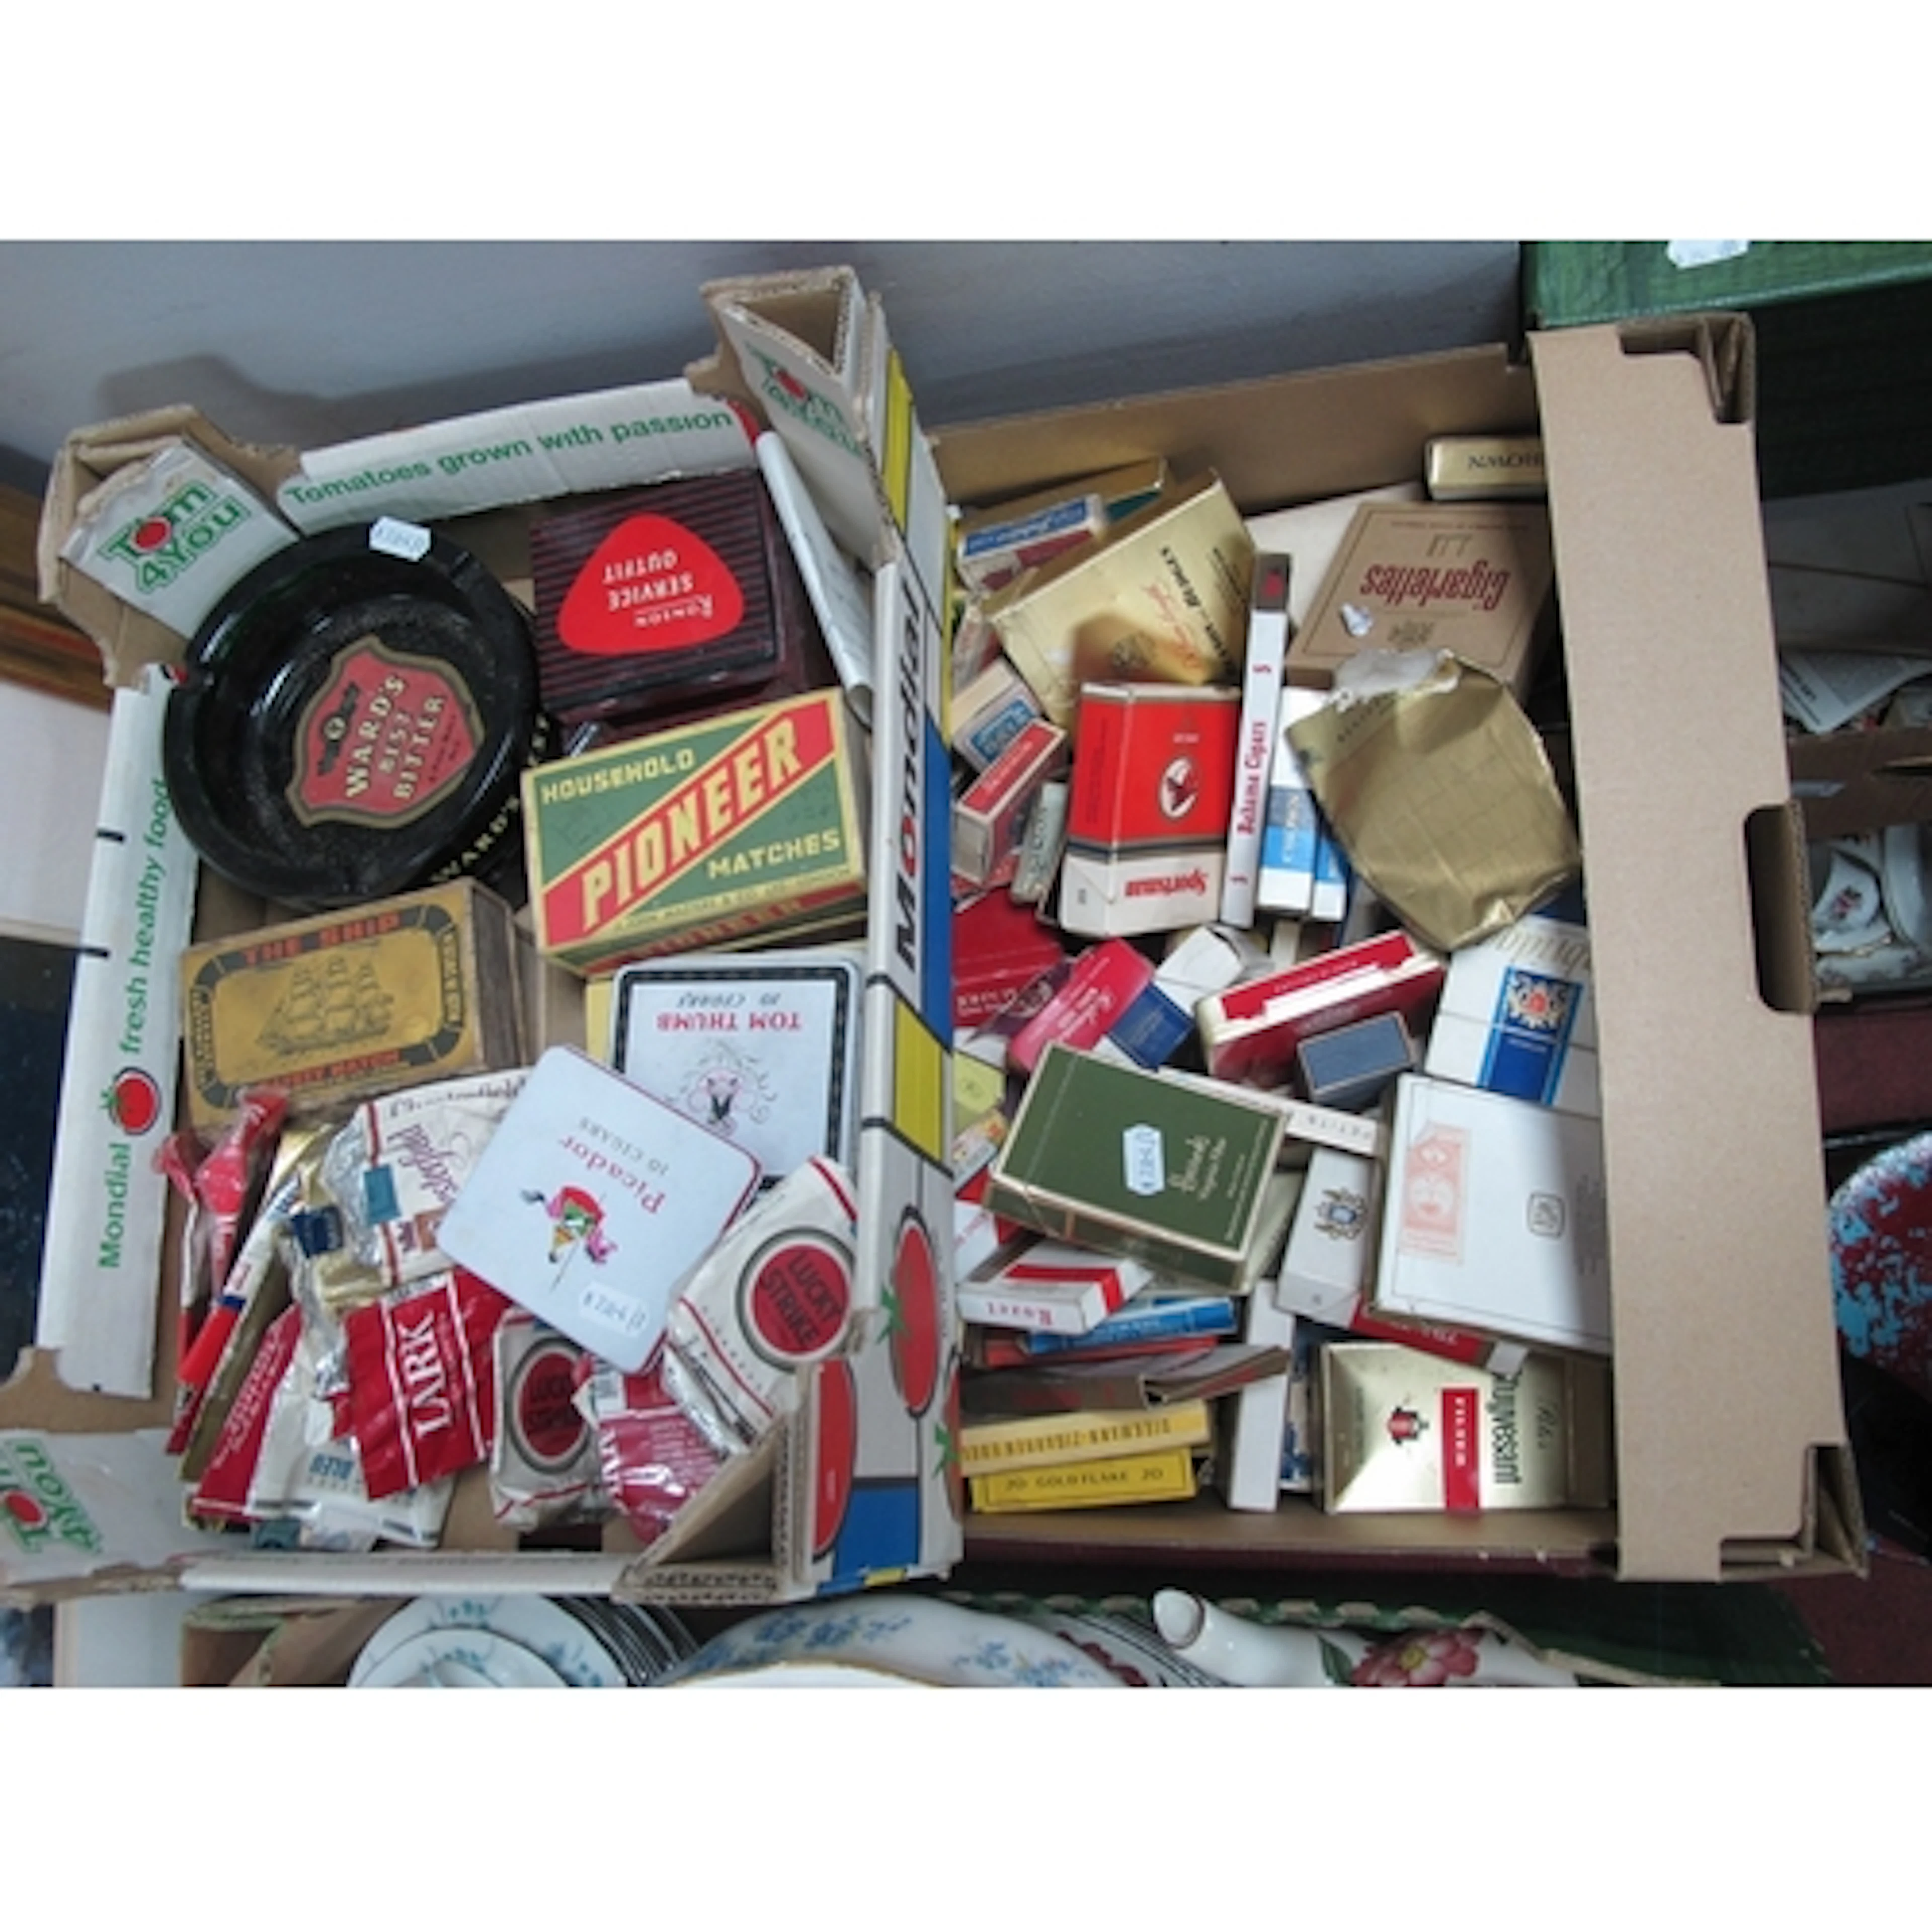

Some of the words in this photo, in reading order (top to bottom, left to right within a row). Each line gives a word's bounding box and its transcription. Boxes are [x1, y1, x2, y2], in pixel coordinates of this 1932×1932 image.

[285, 462, 431, 506] Tomatoes
[438, 441, 532, 476] grown
[537, 424, 603, 453] with
[610, 409, 734, 444] passion
[101, 479, 214, 561] Tom
[138, 497, 247, 591] 4You
[603, 549, 679, 585] OUTFIT
[608, 572, 694, 612] SERVICE
[346, 674, 409, 798] WARD'S
[393, 695, 446, 799] BITTER
[539, 748, 694, 804] HOUSEHOLD
[143, 779, 173, 851] food
[580, 717, 802, 935] PIONEER
[708, 828, 841, 879] MATCHES
[130, 857, 168, 969] healthy
[244, 935, 301, 965] THE
[318, 911, 400, 944] SHIP
[119, 975, 147, 1055] fresh
[657, 1012, 740, 1032] THUMB
[748, 1012, 802, 1031] TOM
[100, 1142, 131, 1268] Mondial
[558, 1133, 666, 1215] Picador
[763, 1268, 819, 1346] STRIKE
[787, 1253, 843, 1322] LUCKY
[397, 1311, 452, 1439] LARK
